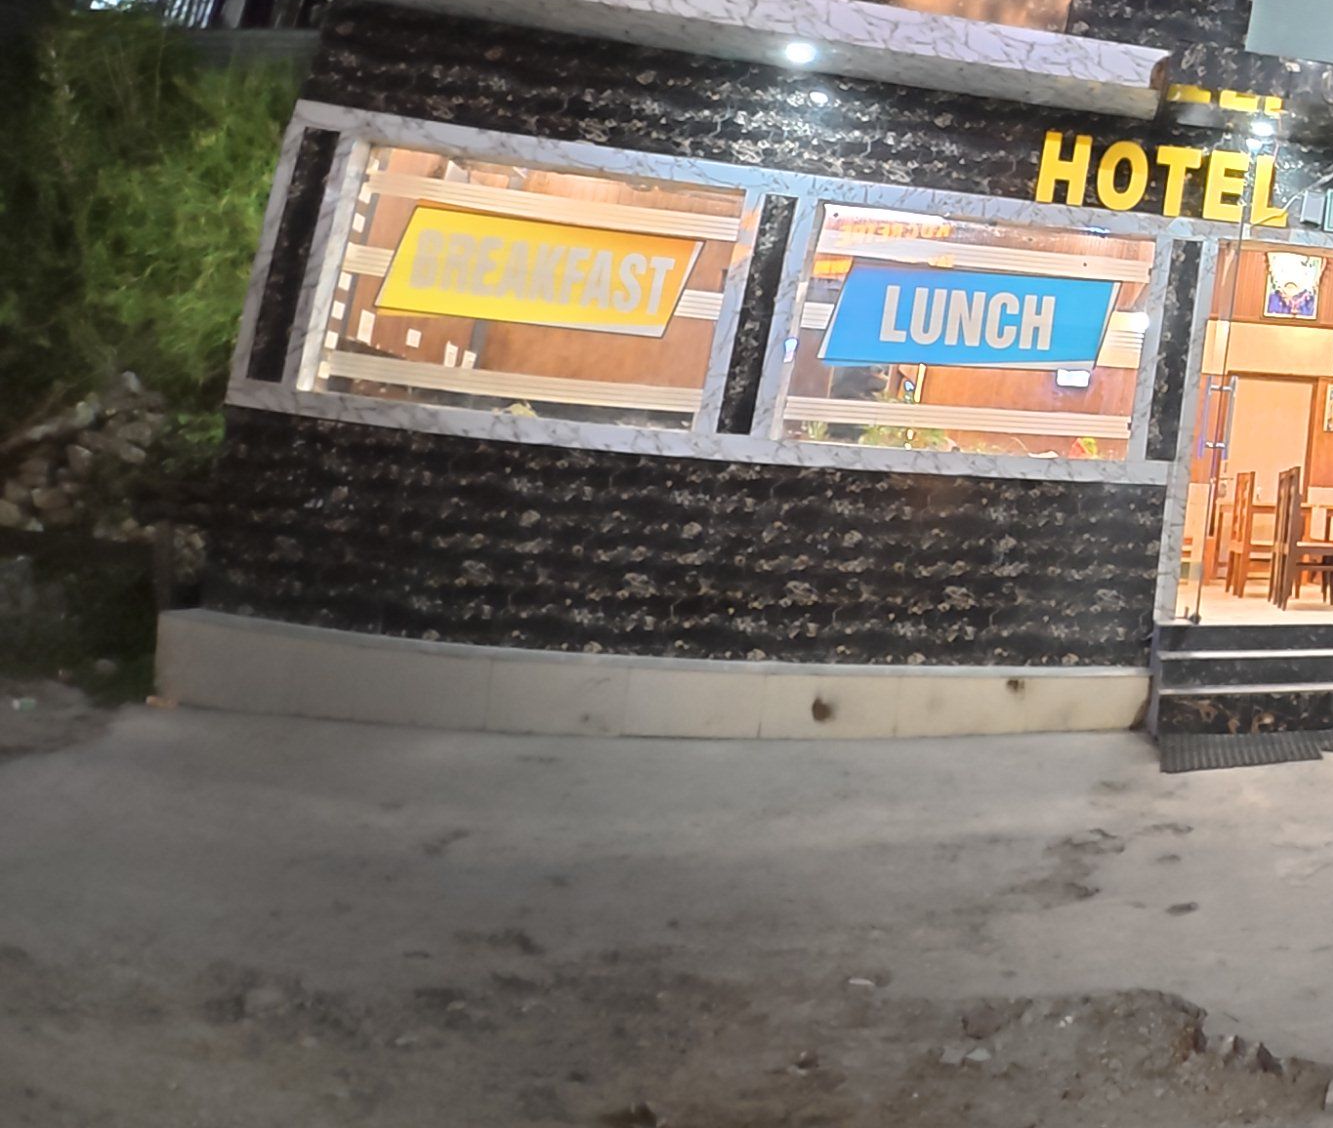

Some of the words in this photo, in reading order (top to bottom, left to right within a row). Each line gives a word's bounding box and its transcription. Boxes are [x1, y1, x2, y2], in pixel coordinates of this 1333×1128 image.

[1035, 131, 1289, 227] HOTEL
[409, 228, 675, 315] BREAKFAST
[879, 285, 1056, 351] LUNCH
